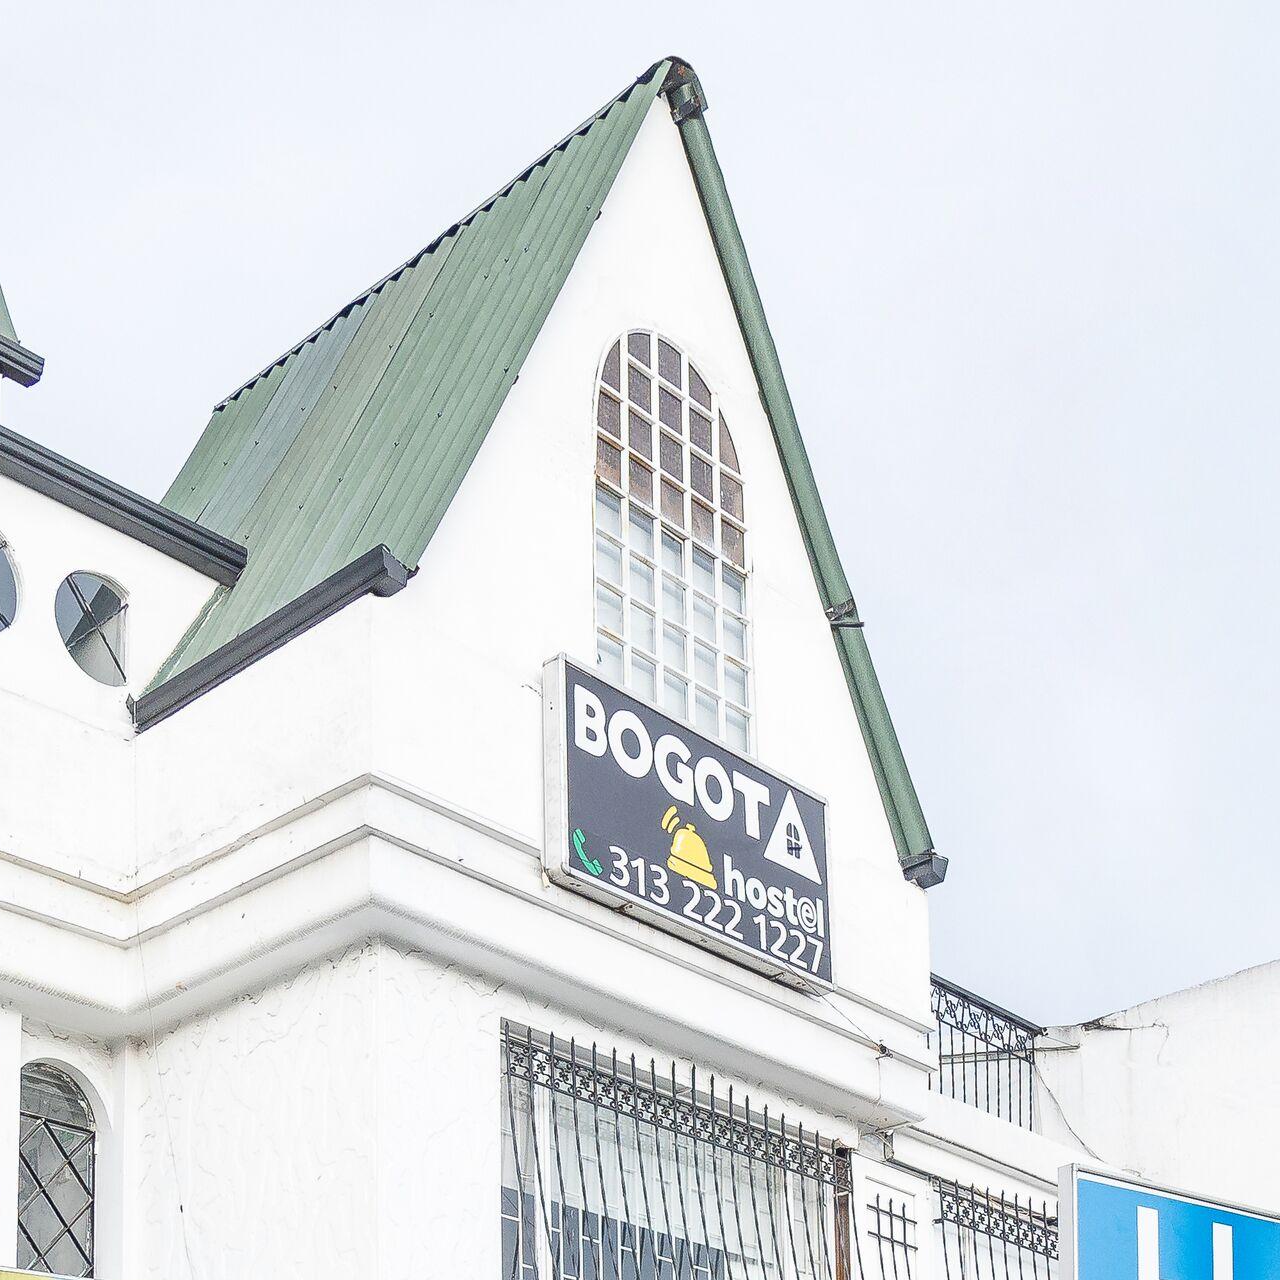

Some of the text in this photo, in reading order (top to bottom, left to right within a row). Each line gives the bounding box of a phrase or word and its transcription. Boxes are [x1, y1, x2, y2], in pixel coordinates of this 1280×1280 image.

[574, 683, 822, 884] BOGOTA
[609, 846, 824, 973] 313 222 1227
